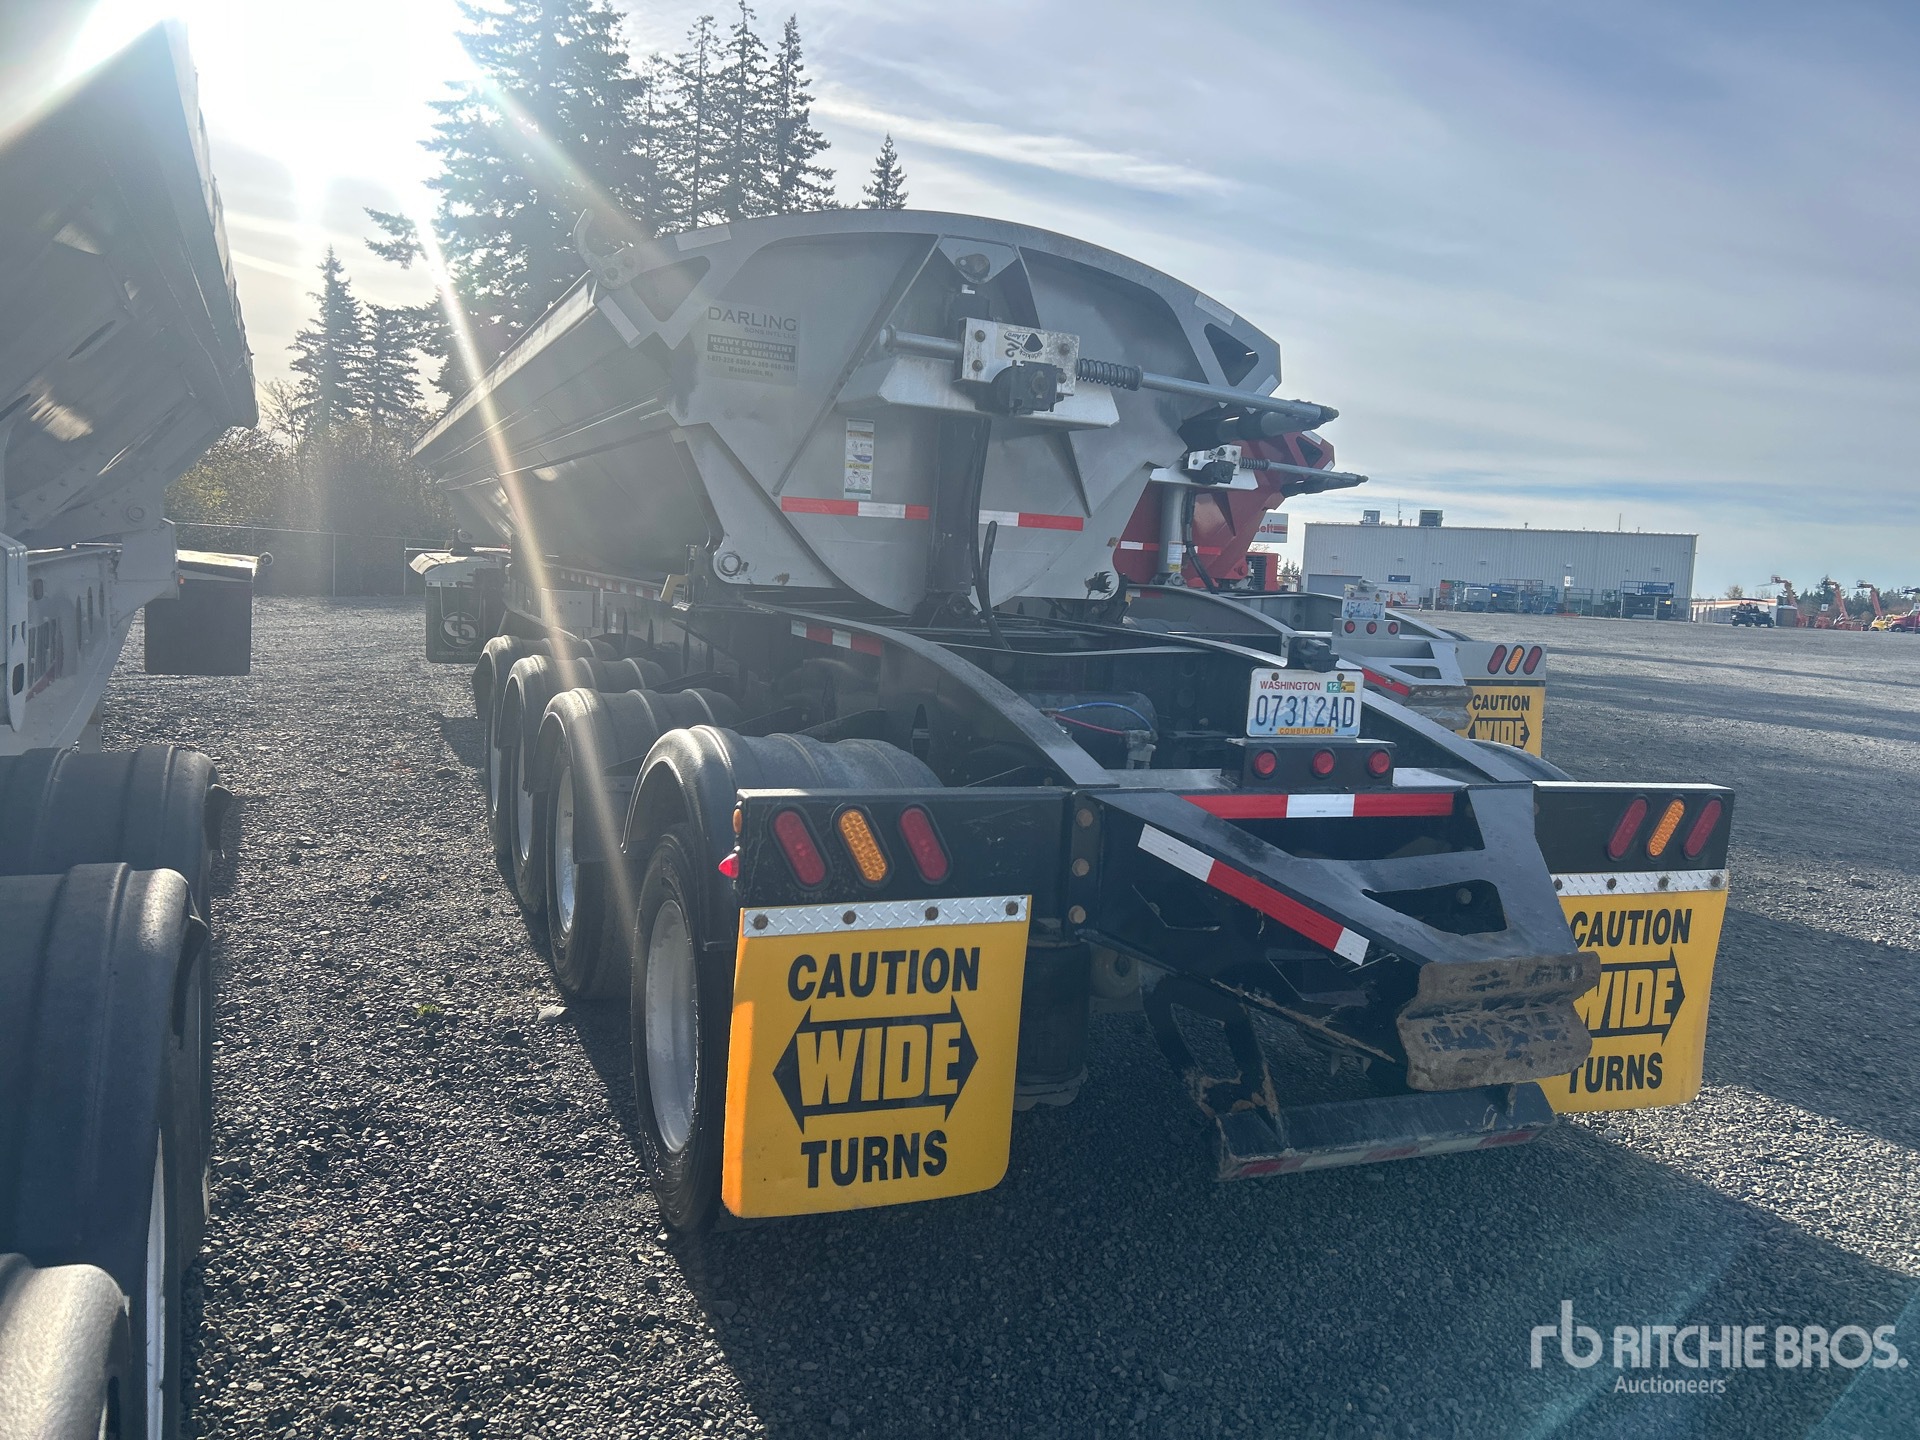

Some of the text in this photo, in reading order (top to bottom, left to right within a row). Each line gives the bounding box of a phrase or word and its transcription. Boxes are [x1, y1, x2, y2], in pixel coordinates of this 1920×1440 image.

[708, 306, 797, 332] DARLING
[744, 327, 764, 335] SONS
[710, 335, 793, 353] HEAVY EQUIPMENT
[712, 344, 741, 354] SALES
[751, 349, 790, 361] RENTALS
[1260, 680, 1321, 691] WASHINGTON
[1327, 682, 1339, 691] 12
[1255, 694, 1355, 728] 07312AD
[1472, 694, 1531, 711] CAUTION
[1279, 727, 1332, 735] COMBINATION
[1474, 720, 1525, 747] WIDE
[1569, 908, 1693, 948] CAUTION
[787, 946, 981, 1002] CAUTION
[796, 1021, 963, 1107] WIDE
[800, 1129, 948, 1189] TURNS
